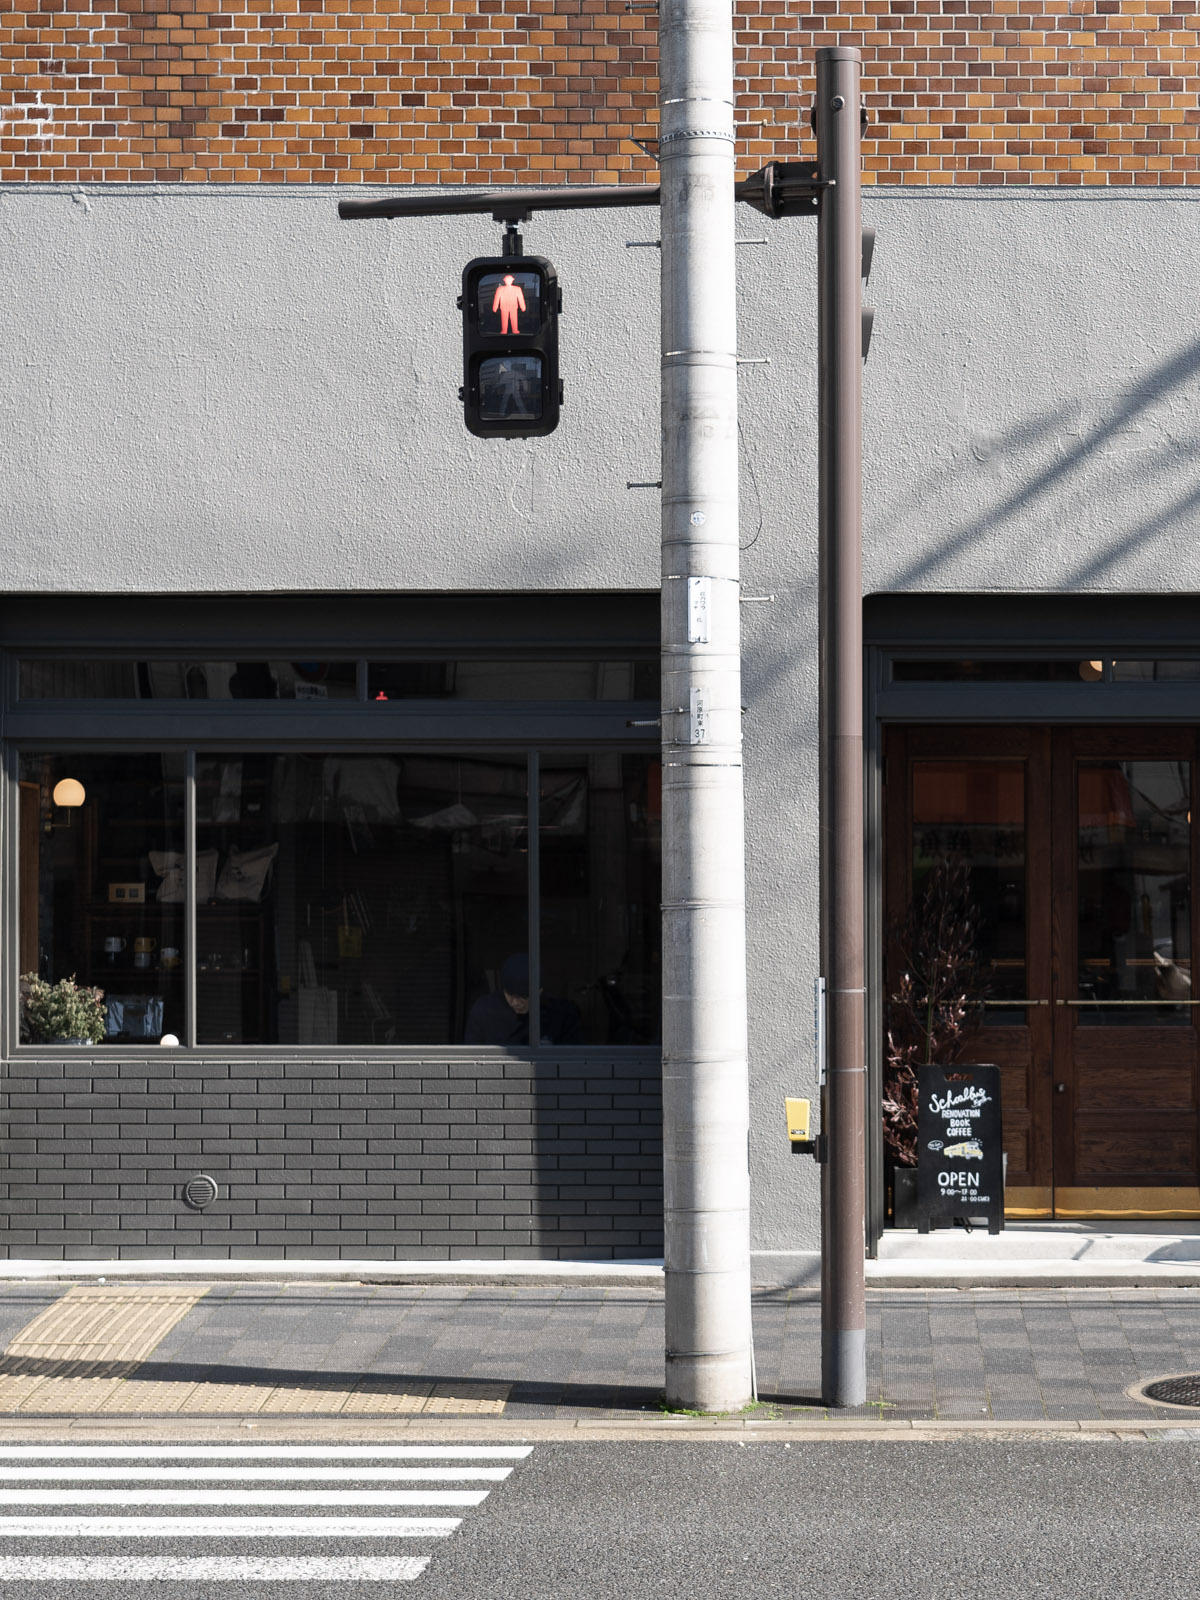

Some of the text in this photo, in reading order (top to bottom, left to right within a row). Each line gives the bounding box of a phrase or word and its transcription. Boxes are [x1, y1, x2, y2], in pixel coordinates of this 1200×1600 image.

[694, 728, 706, 739] 37
[941, 1109, 981, 1118] RENOVATION
[946, 1128, 972, 1137] COFFEE
[937, 1171, 980, 1187] OPEN
